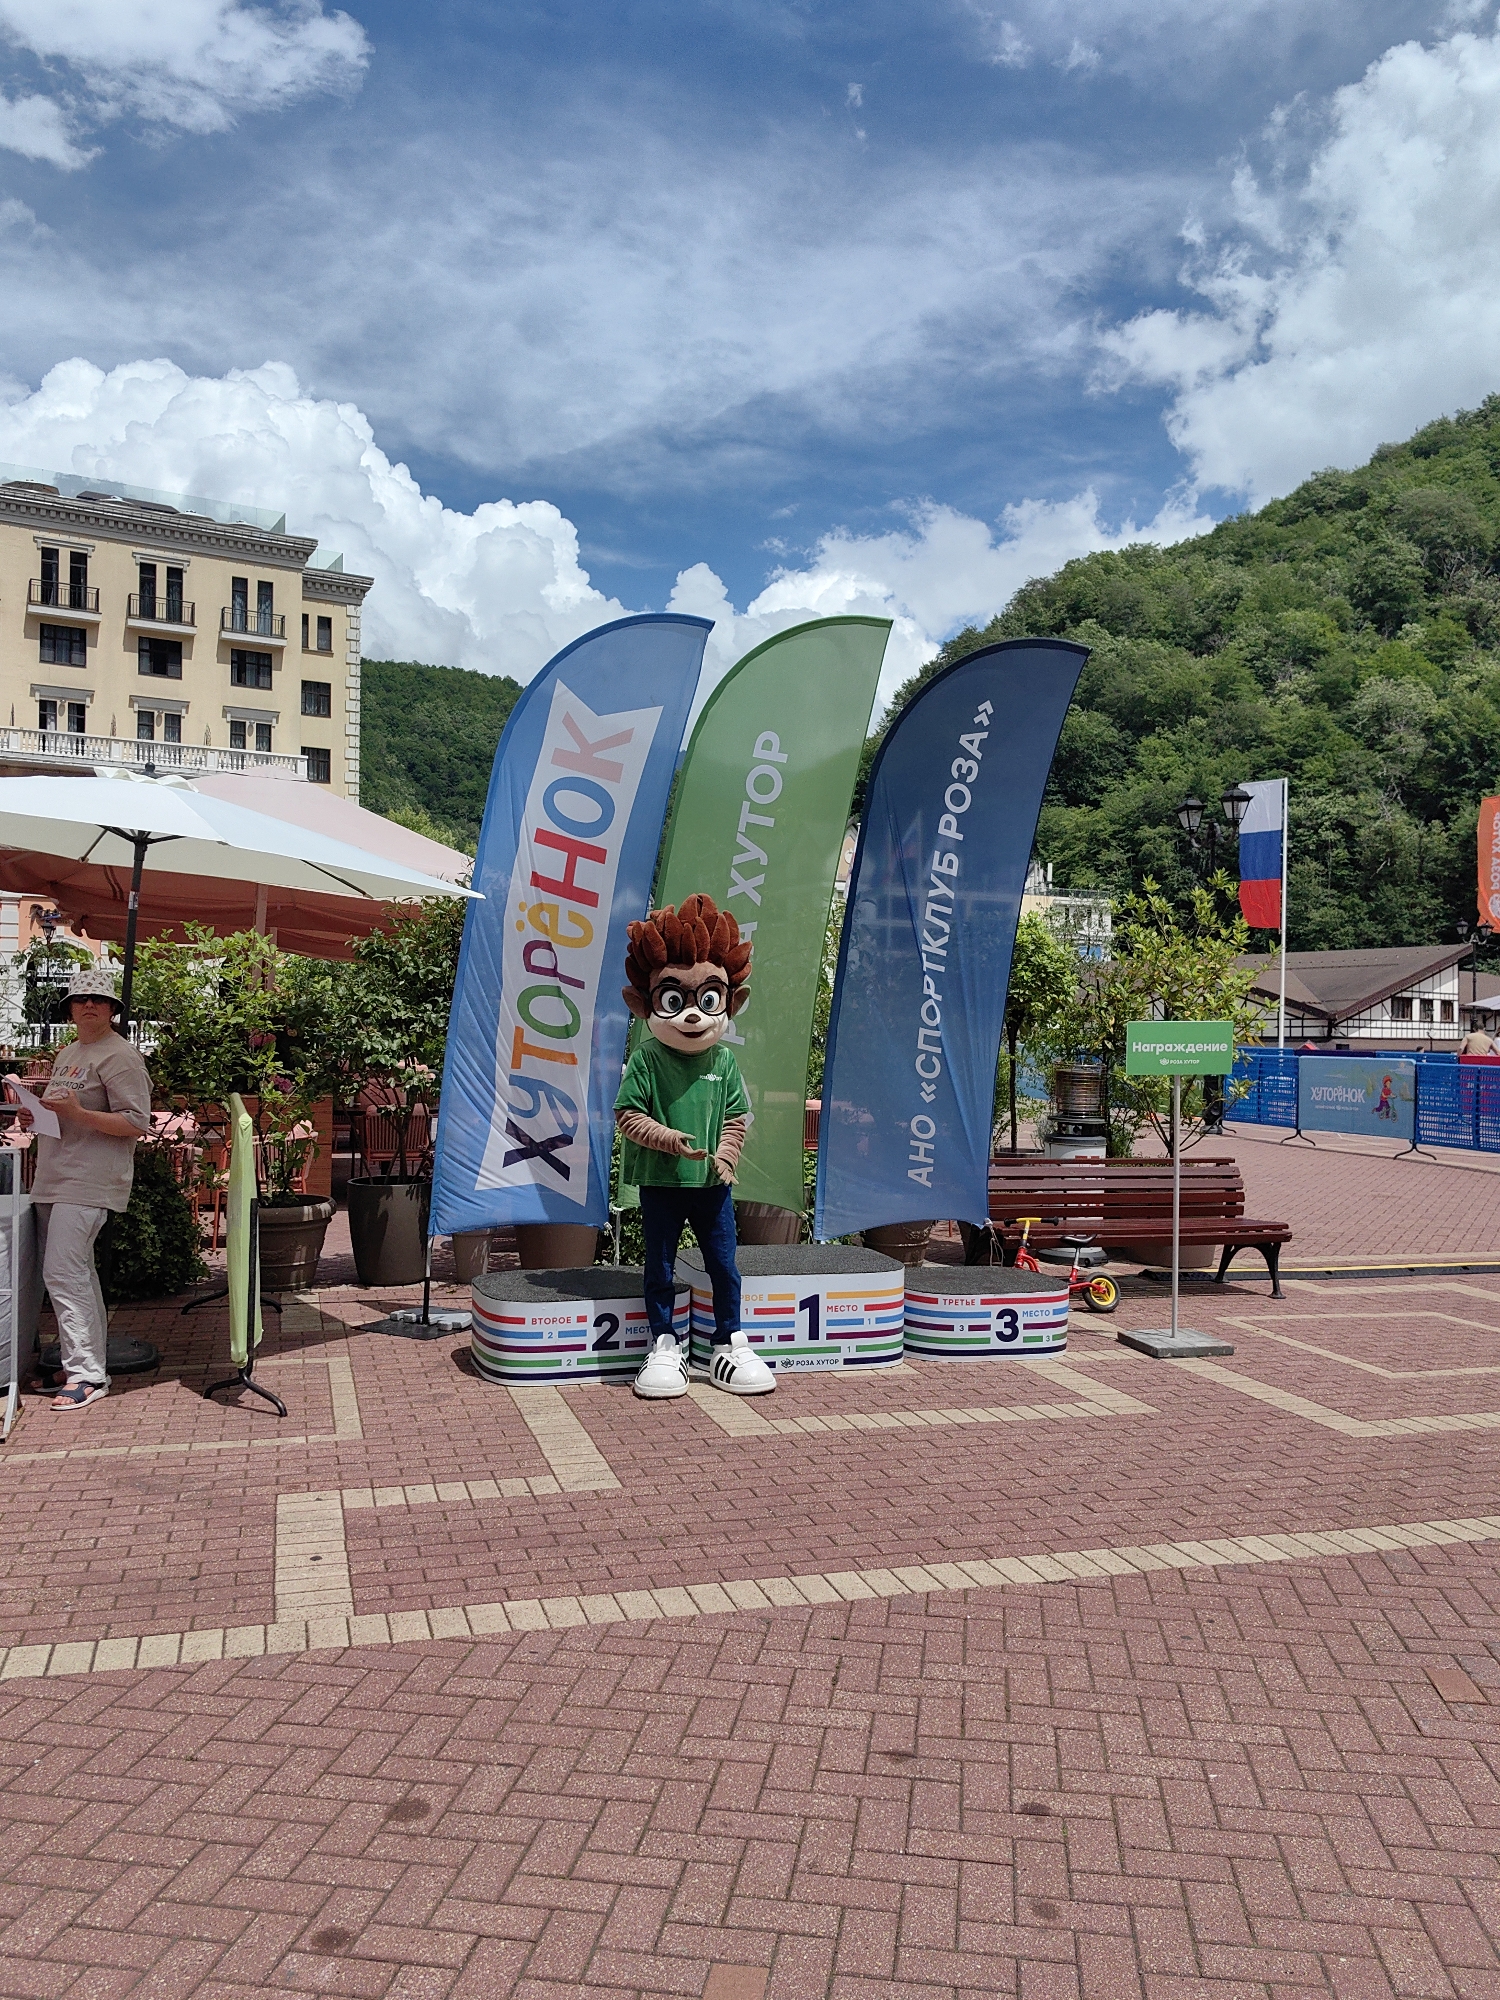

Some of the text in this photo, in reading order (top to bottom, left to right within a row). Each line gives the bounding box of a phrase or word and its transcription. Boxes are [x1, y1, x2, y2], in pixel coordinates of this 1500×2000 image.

[727, 730, 789, 907] ХУТОР
[908, 700, 994, 1188] АНО «СПОРТКЛУБ РОЗА»
[1132, 1042, 1228, 1055] Награждение
[826, 1305, 858, 1313] МЕСТО
[1022, 1309, 1050, 1318] МЕСТО
[531, 1316, 572, 1325] ВТОРОЕ
[799, 1294, 820, 1341] 1
[625, 1326, 651, 1335] МЕСТ
[995, 1308, 1019, 1343] 3
[547, 1331, 553, 1339] 2
[592, 1313, 620, 1351] 2
[566, 1358, 572, 1367] 2
